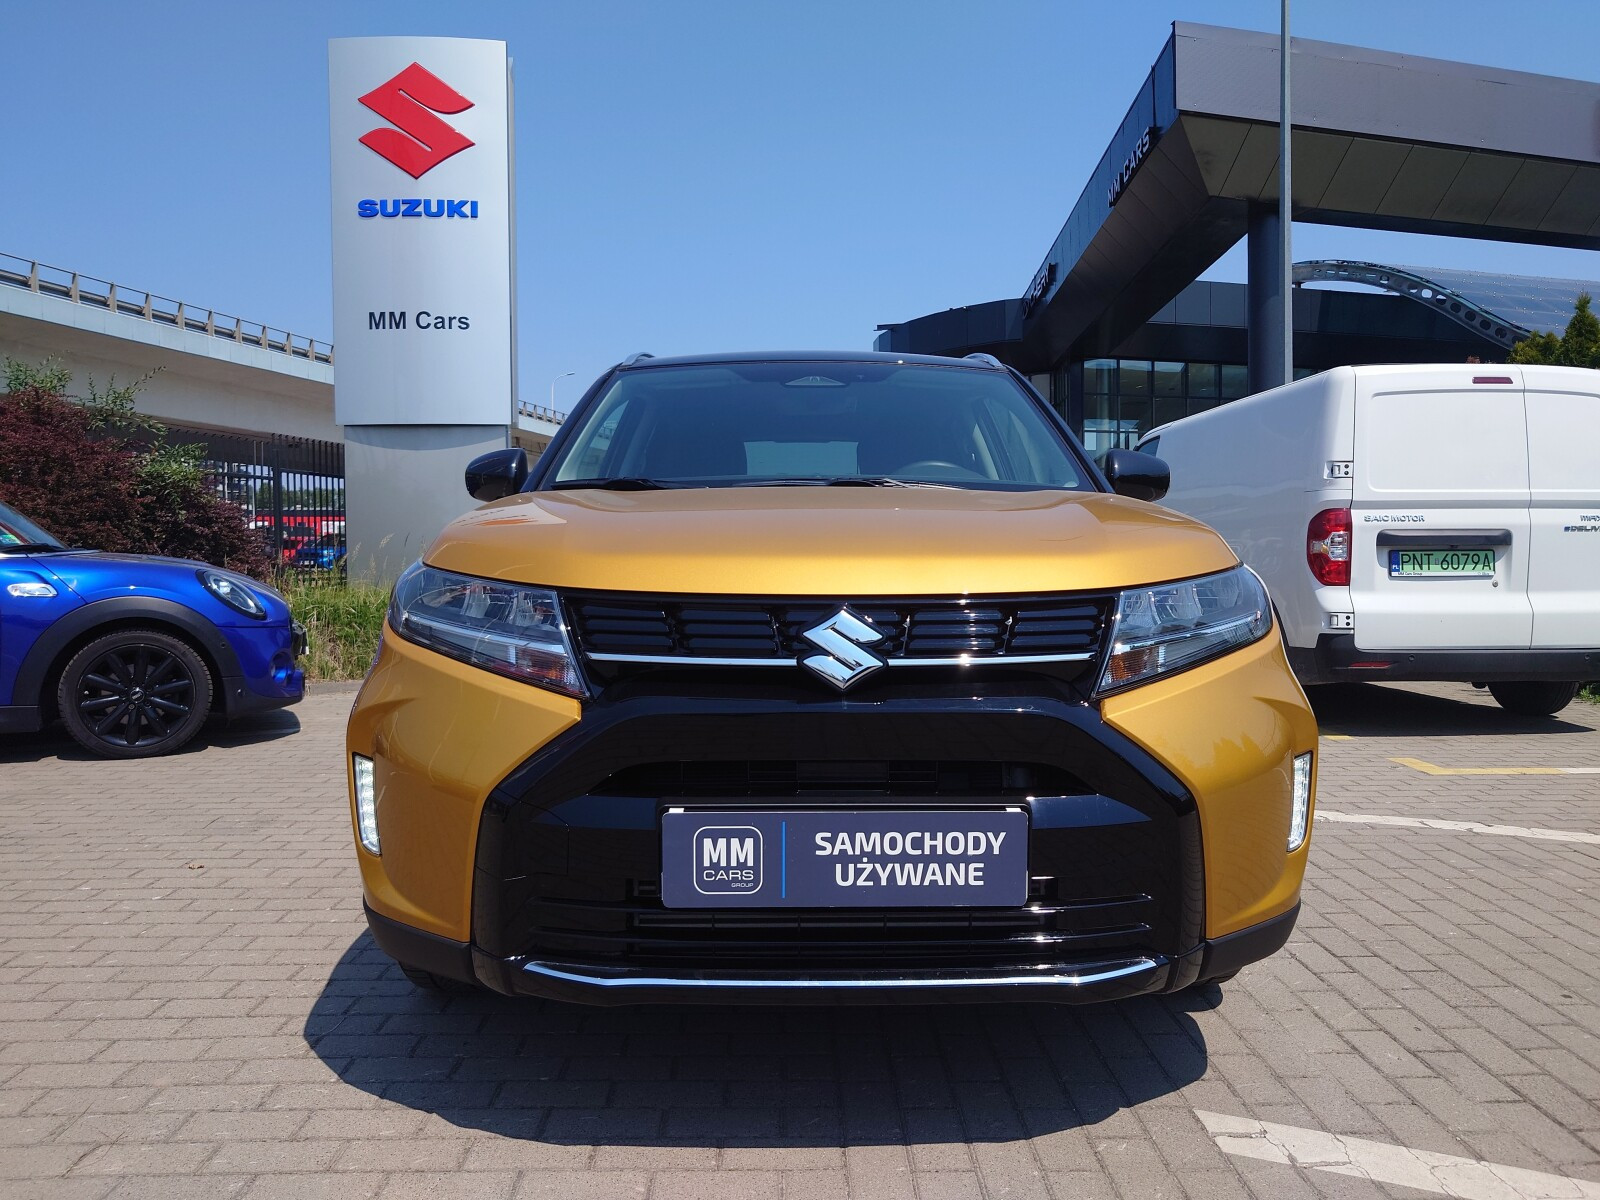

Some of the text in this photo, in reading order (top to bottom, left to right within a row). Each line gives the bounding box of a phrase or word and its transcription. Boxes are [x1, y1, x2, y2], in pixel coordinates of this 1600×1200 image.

[1107, 126, 1150, 208] MM CARS
[358, 199, 479, 218] SUZUKI
[368, 311, 471, 330] MM Cars
[1364, 514, 1425, 523] SAIC MOTOR
[1401, 553, 1492, 571] PNT 6079A
[703, 837, 754, 867] MM
[815, 831, 1007, 856] SAMOCHODY
[703, 869, 754, 881] CARS
[835, 857, 985, 887] UŻYWANE
